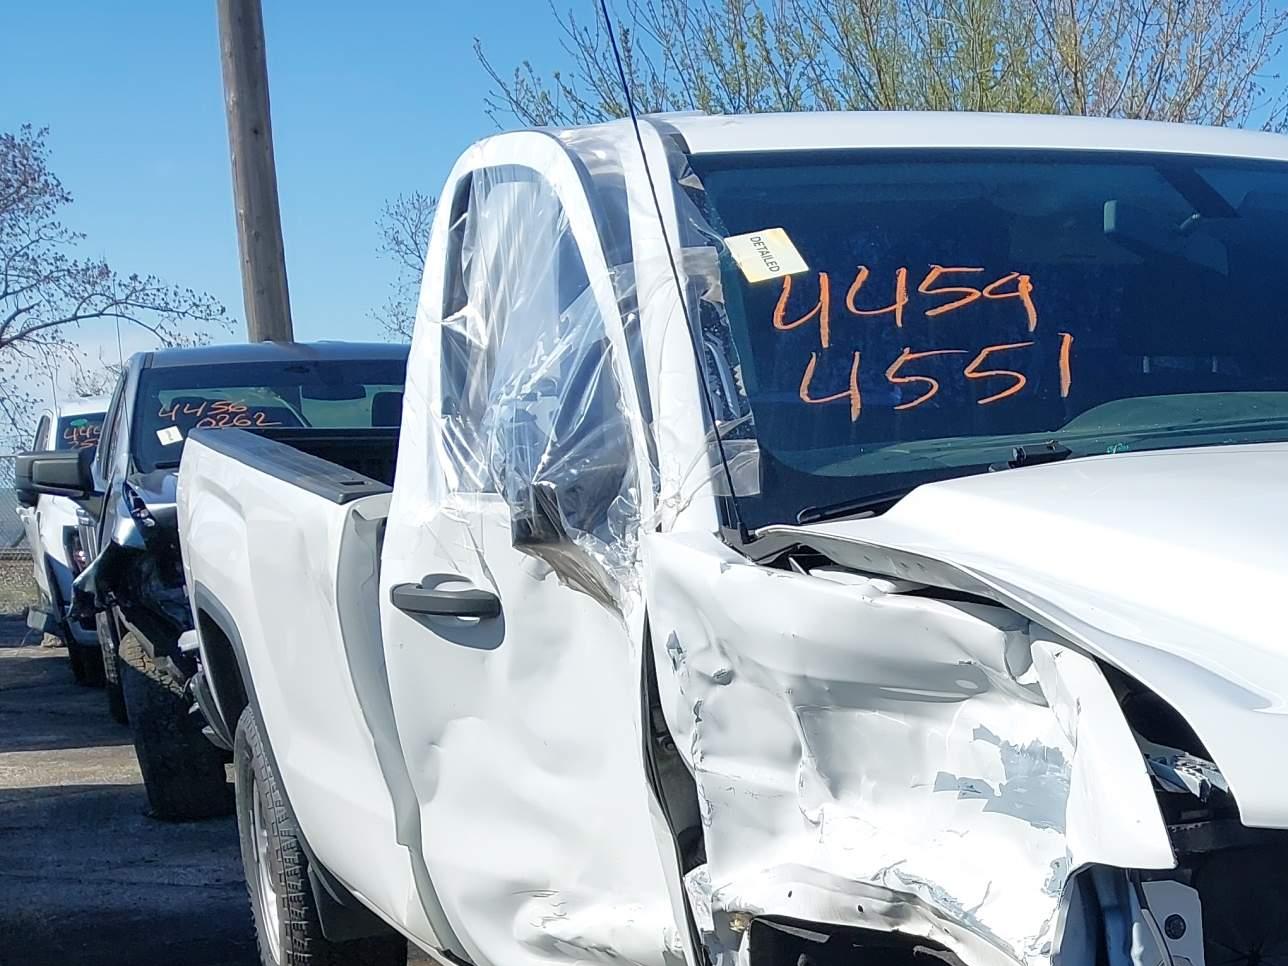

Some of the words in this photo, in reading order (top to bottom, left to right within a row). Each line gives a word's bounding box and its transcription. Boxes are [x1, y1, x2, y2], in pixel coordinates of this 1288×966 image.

[750, 235, 780, 273] DETAILED
[772, 264, 1038, 349] 4459
[799, 332, 1075, 422] 4551
